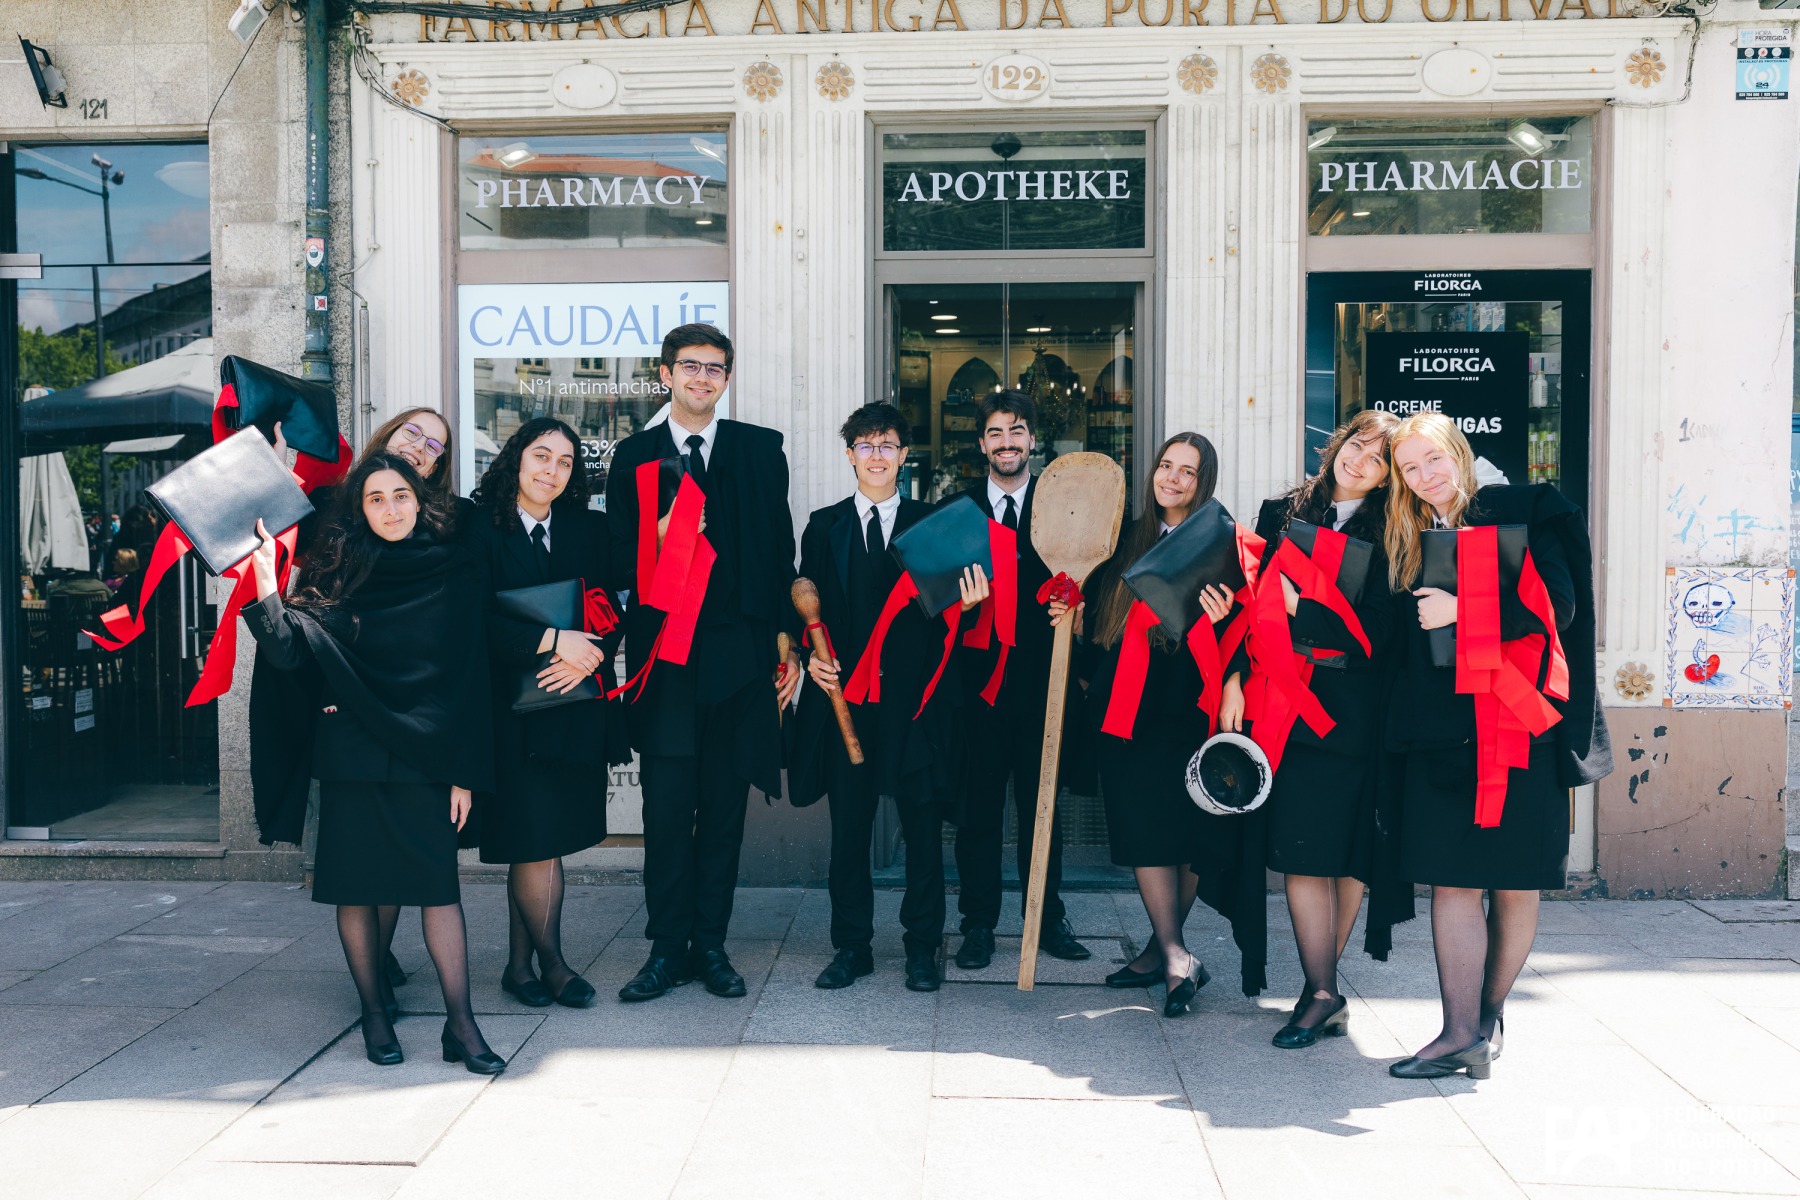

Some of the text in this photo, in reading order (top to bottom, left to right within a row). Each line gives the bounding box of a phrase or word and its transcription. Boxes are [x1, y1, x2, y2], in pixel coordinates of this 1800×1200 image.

[748, 0, 968, 35] ANTIGA
[997, 0, 1073, 30] DA
[1101, 0, 1287, 28] PORTA
[1318, 0, 1393, 24] DO
[990, 65, 1042, 91] 122
[79, 99, 108, 120] 121
[898, 169, 1132, 202] APOTHEKE
[1318, 158, 1583, 193] PHARMACIE
[474, 175, 711, 209] PHARMACY
[1414, 279, 1483, 291] FILORGA
[1399, 357, 1496, 373] FILORGA
[559, 376, 669, 395] antimanchas
[1374, 400, 1442, 414] O CREME
